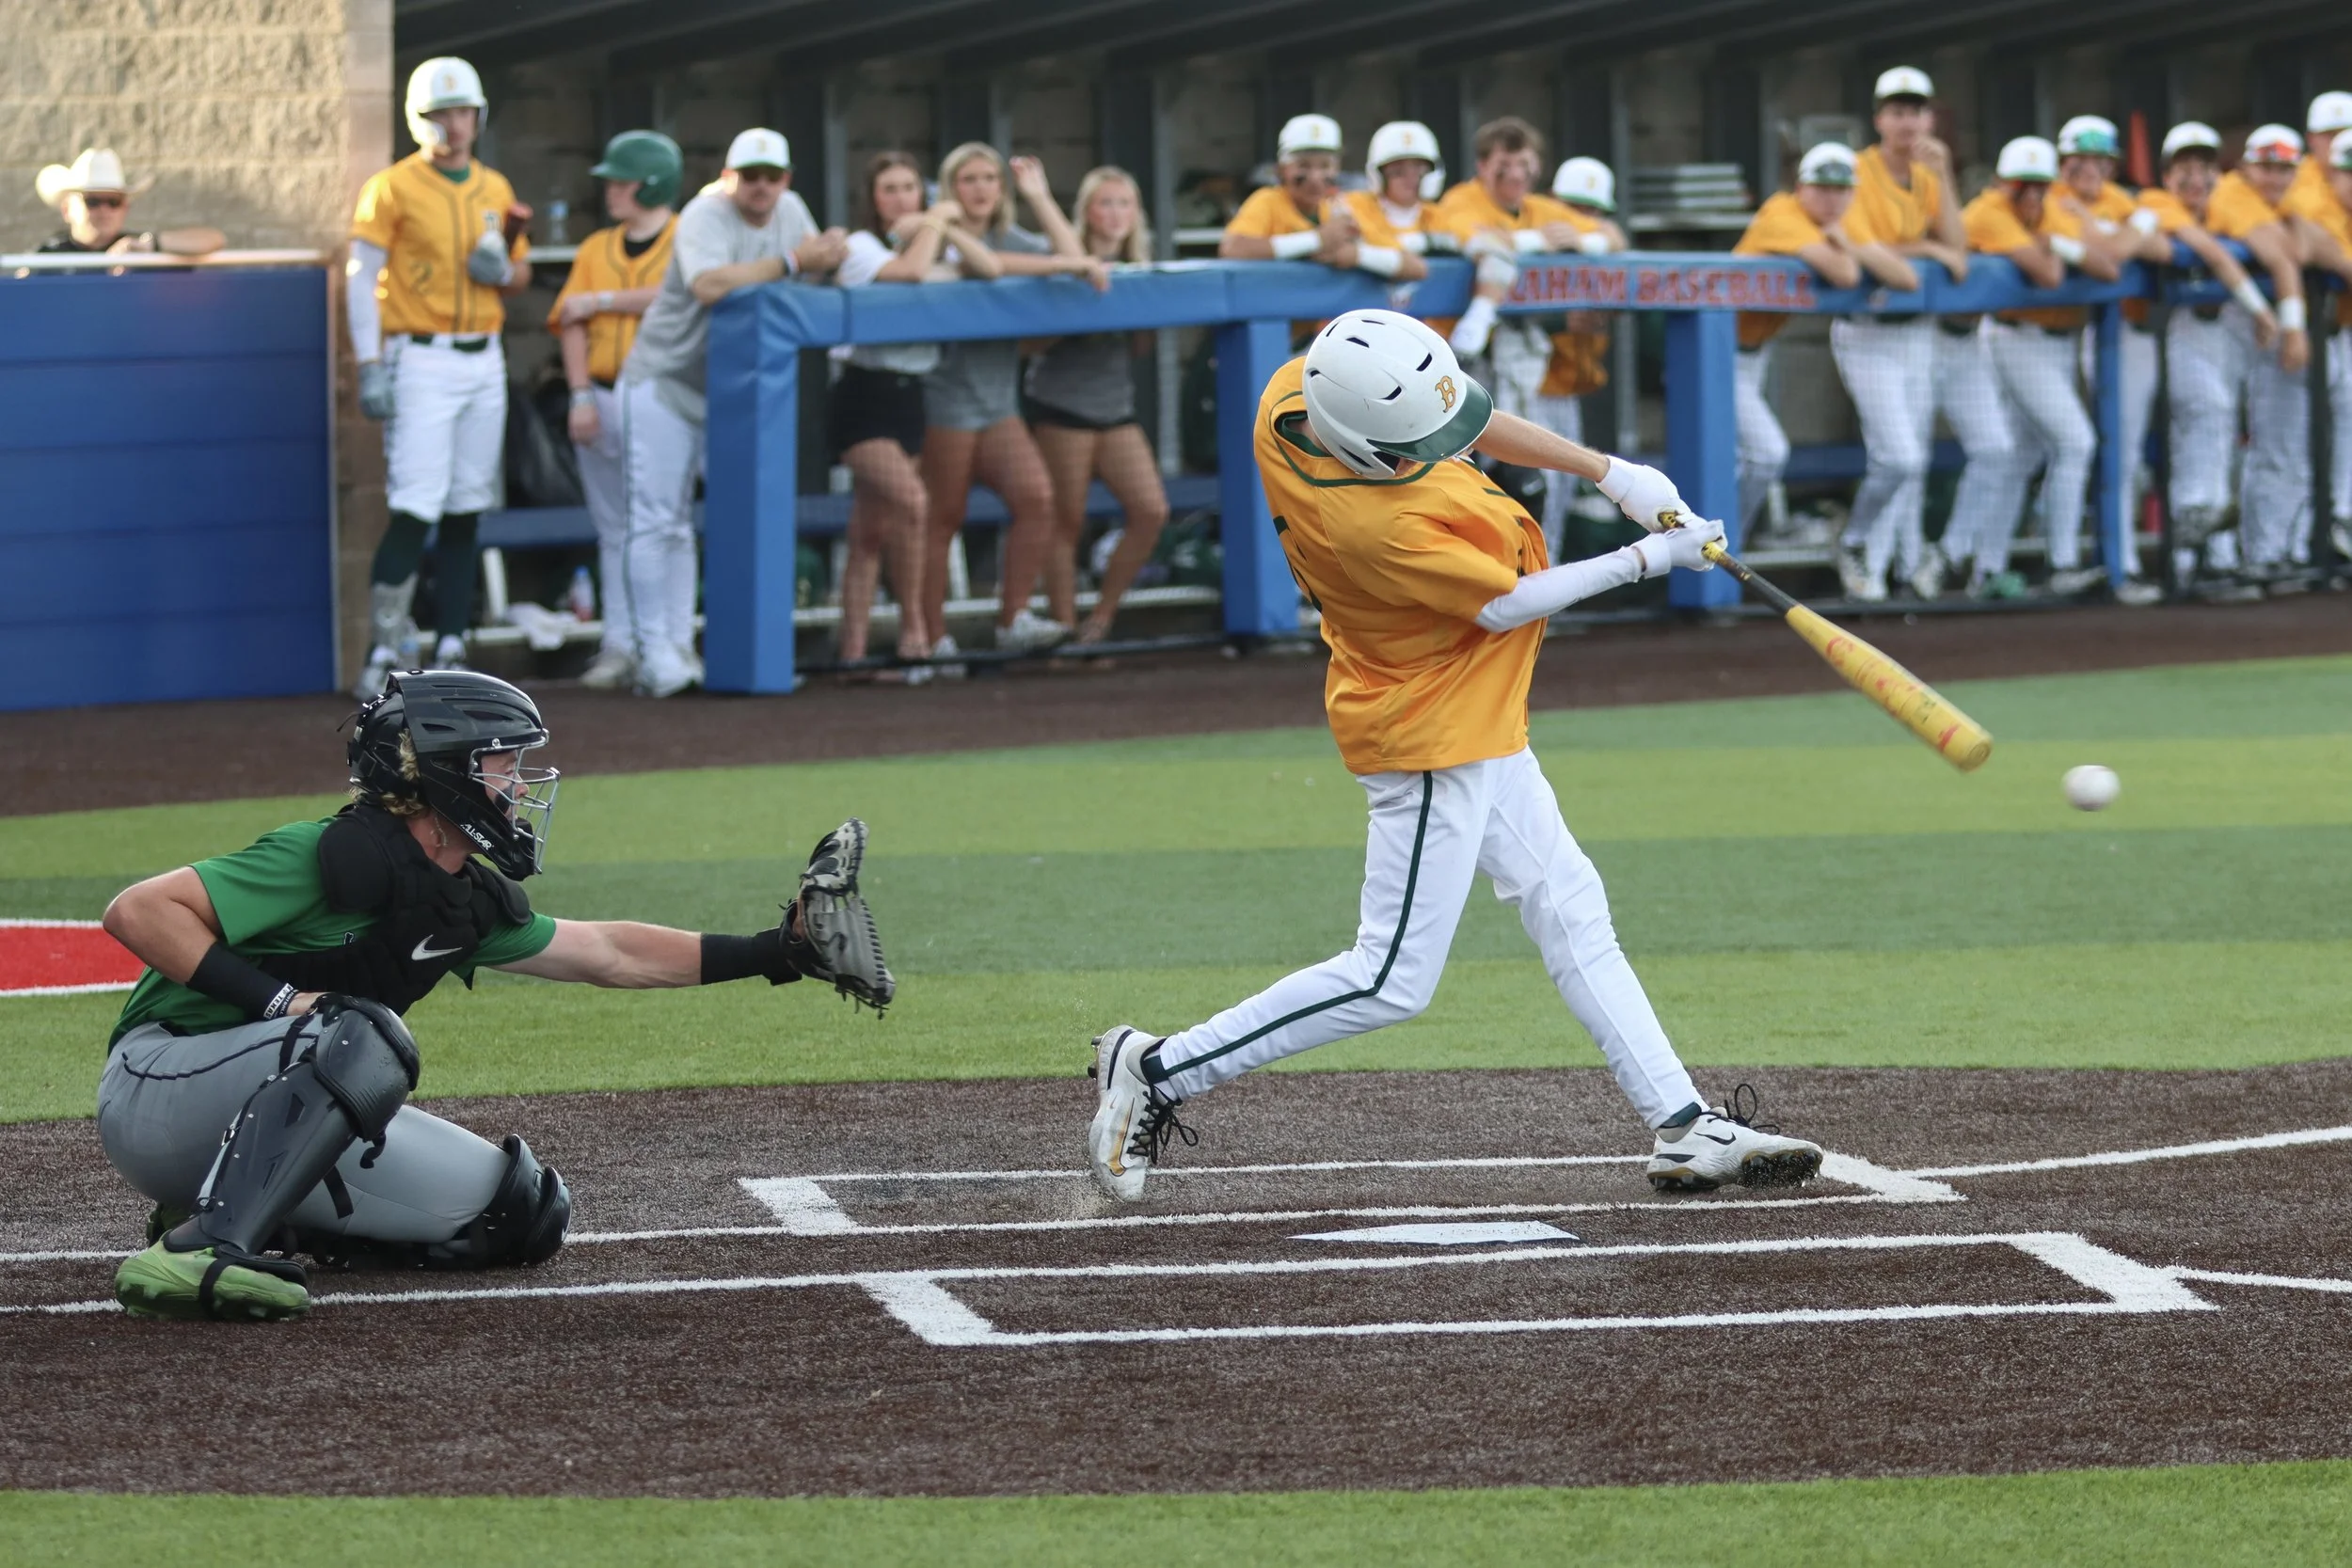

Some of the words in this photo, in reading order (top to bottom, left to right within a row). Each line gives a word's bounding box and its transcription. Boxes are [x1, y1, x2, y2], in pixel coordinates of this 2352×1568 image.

[1508, 267, 1628, 303] AHAM
[1637, 269, 1816, 308] BASEBALL
[1435, 375, 1456, 413] B
[460, 824, 493, 850] ALL-STAR
